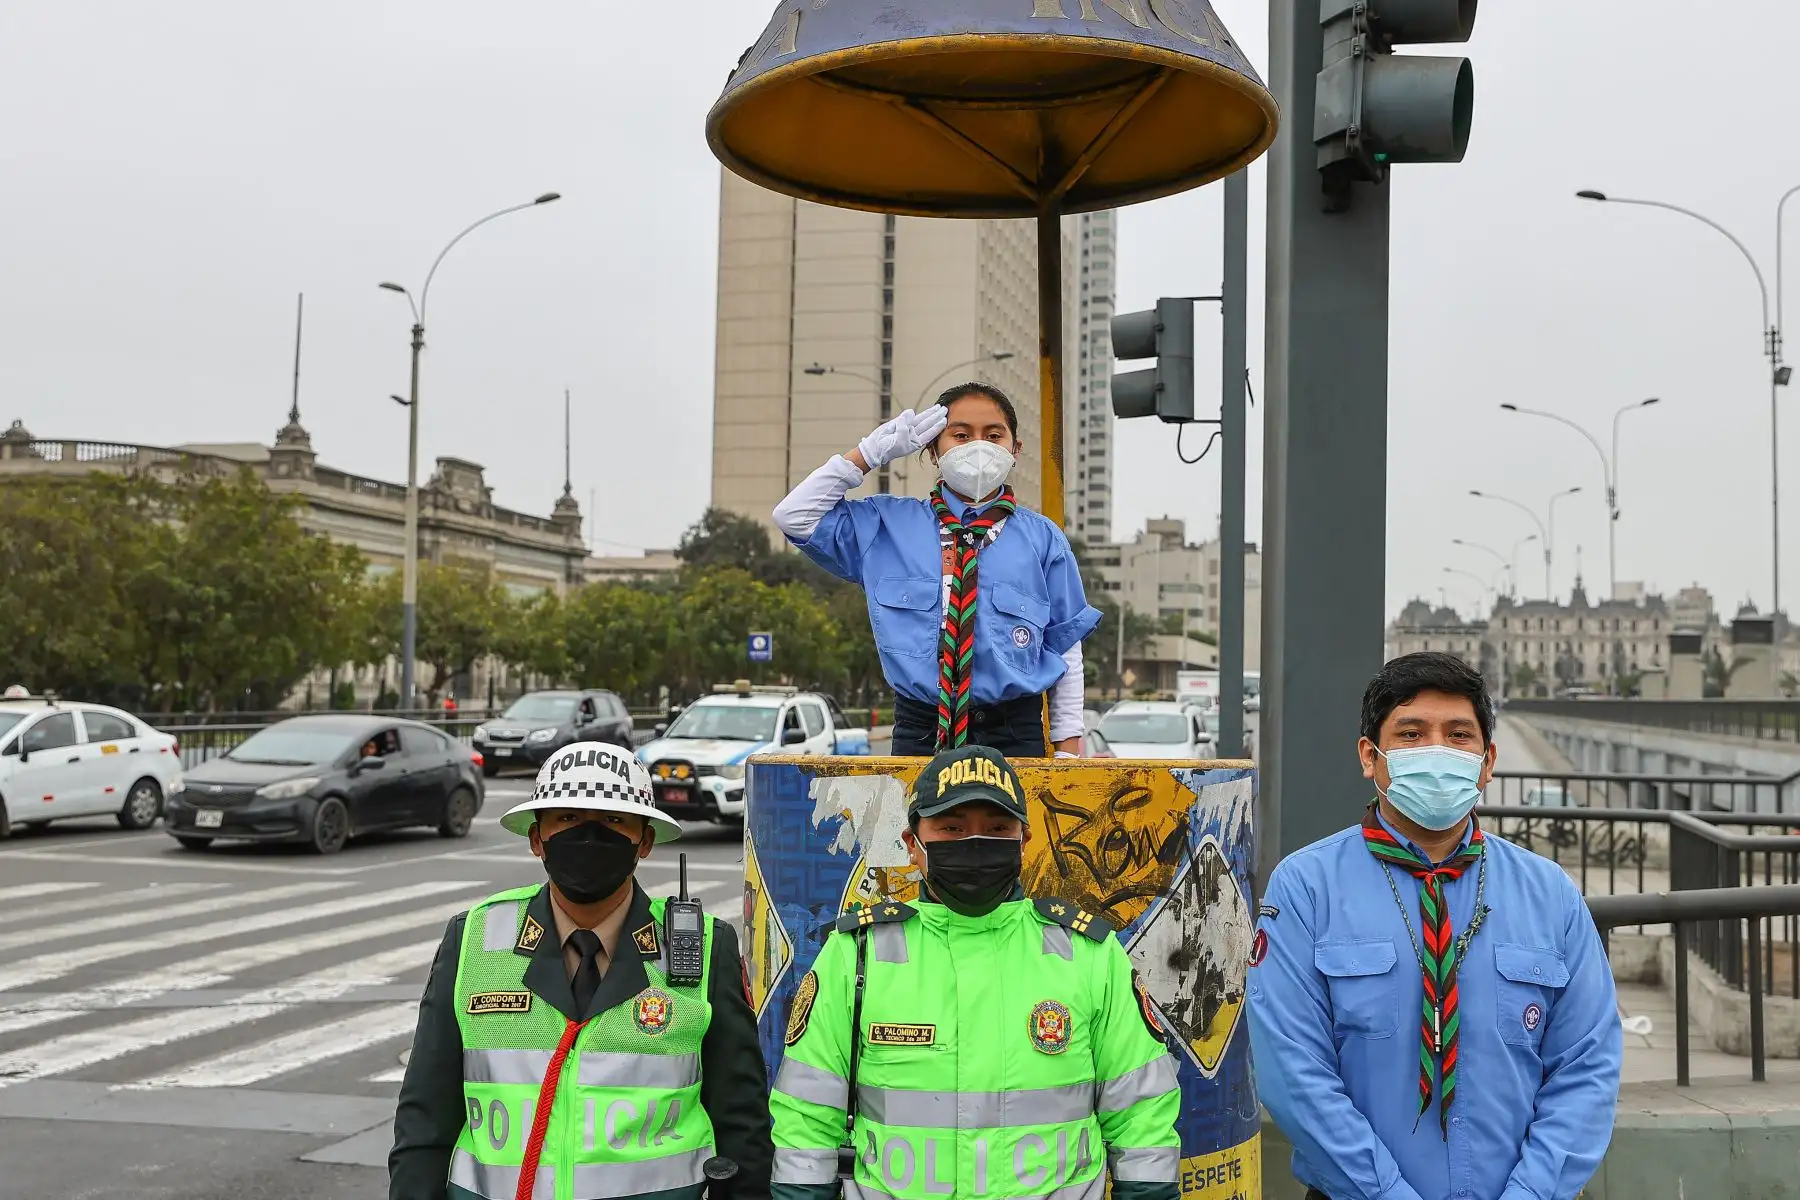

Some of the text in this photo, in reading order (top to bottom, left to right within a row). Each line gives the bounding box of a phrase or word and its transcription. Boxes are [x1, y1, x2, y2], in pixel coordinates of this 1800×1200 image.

[550, 750, 631, 784] POLICIA
[937, 757, 1019, 805] POLICIA
[481, 995, 516, 1004] CONDORI
[518, 995, 526, 1003] V.
[884, 1028, 919, 1037] PALOMINO
[862, 1127, 1092, 1196] POLICIA
